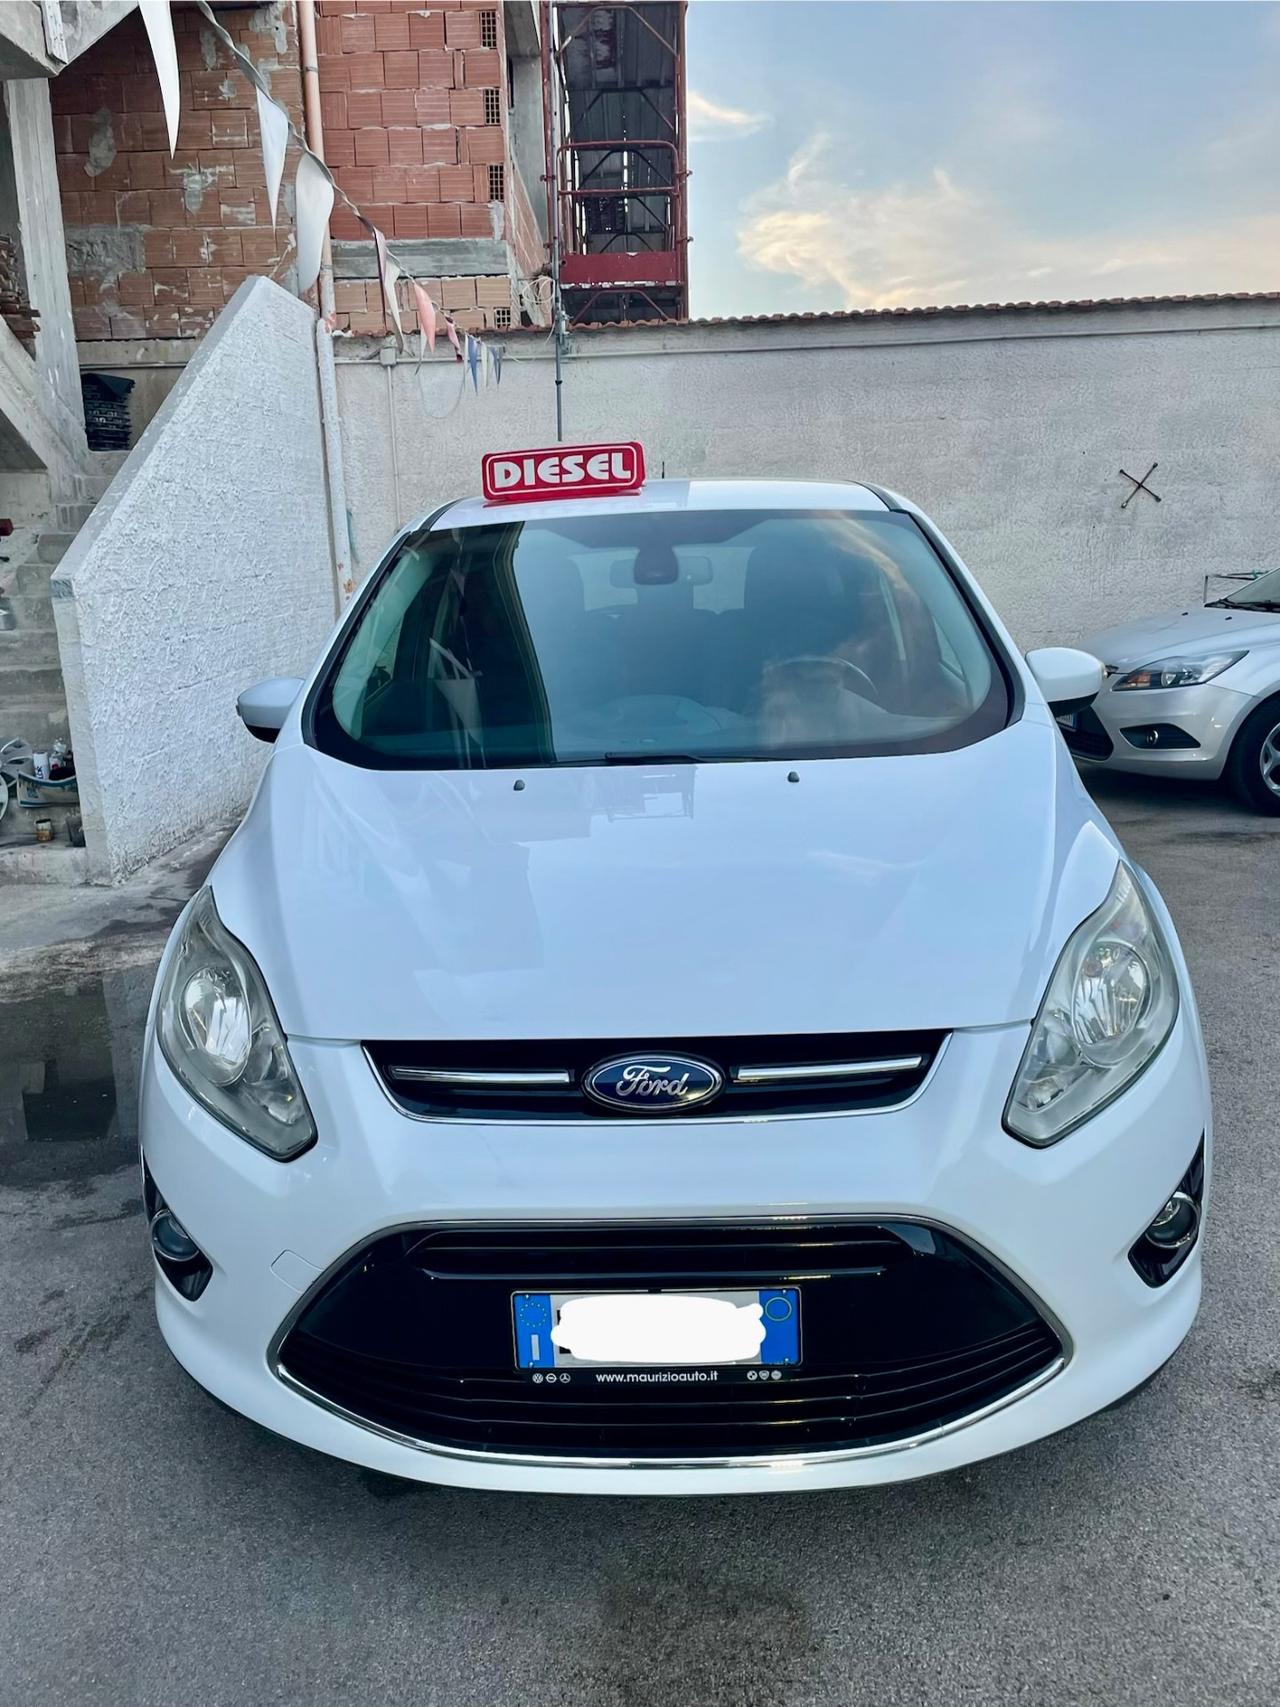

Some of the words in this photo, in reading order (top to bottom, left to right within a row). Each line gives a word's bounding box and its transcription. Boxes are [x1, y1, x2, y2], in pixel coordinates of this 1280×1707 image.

[493, 452, 632, 489] DIESEL
[615, 1065, 690, 1097] Ford
[595, 1370, 719, 1383] www.maurizioauto.it
